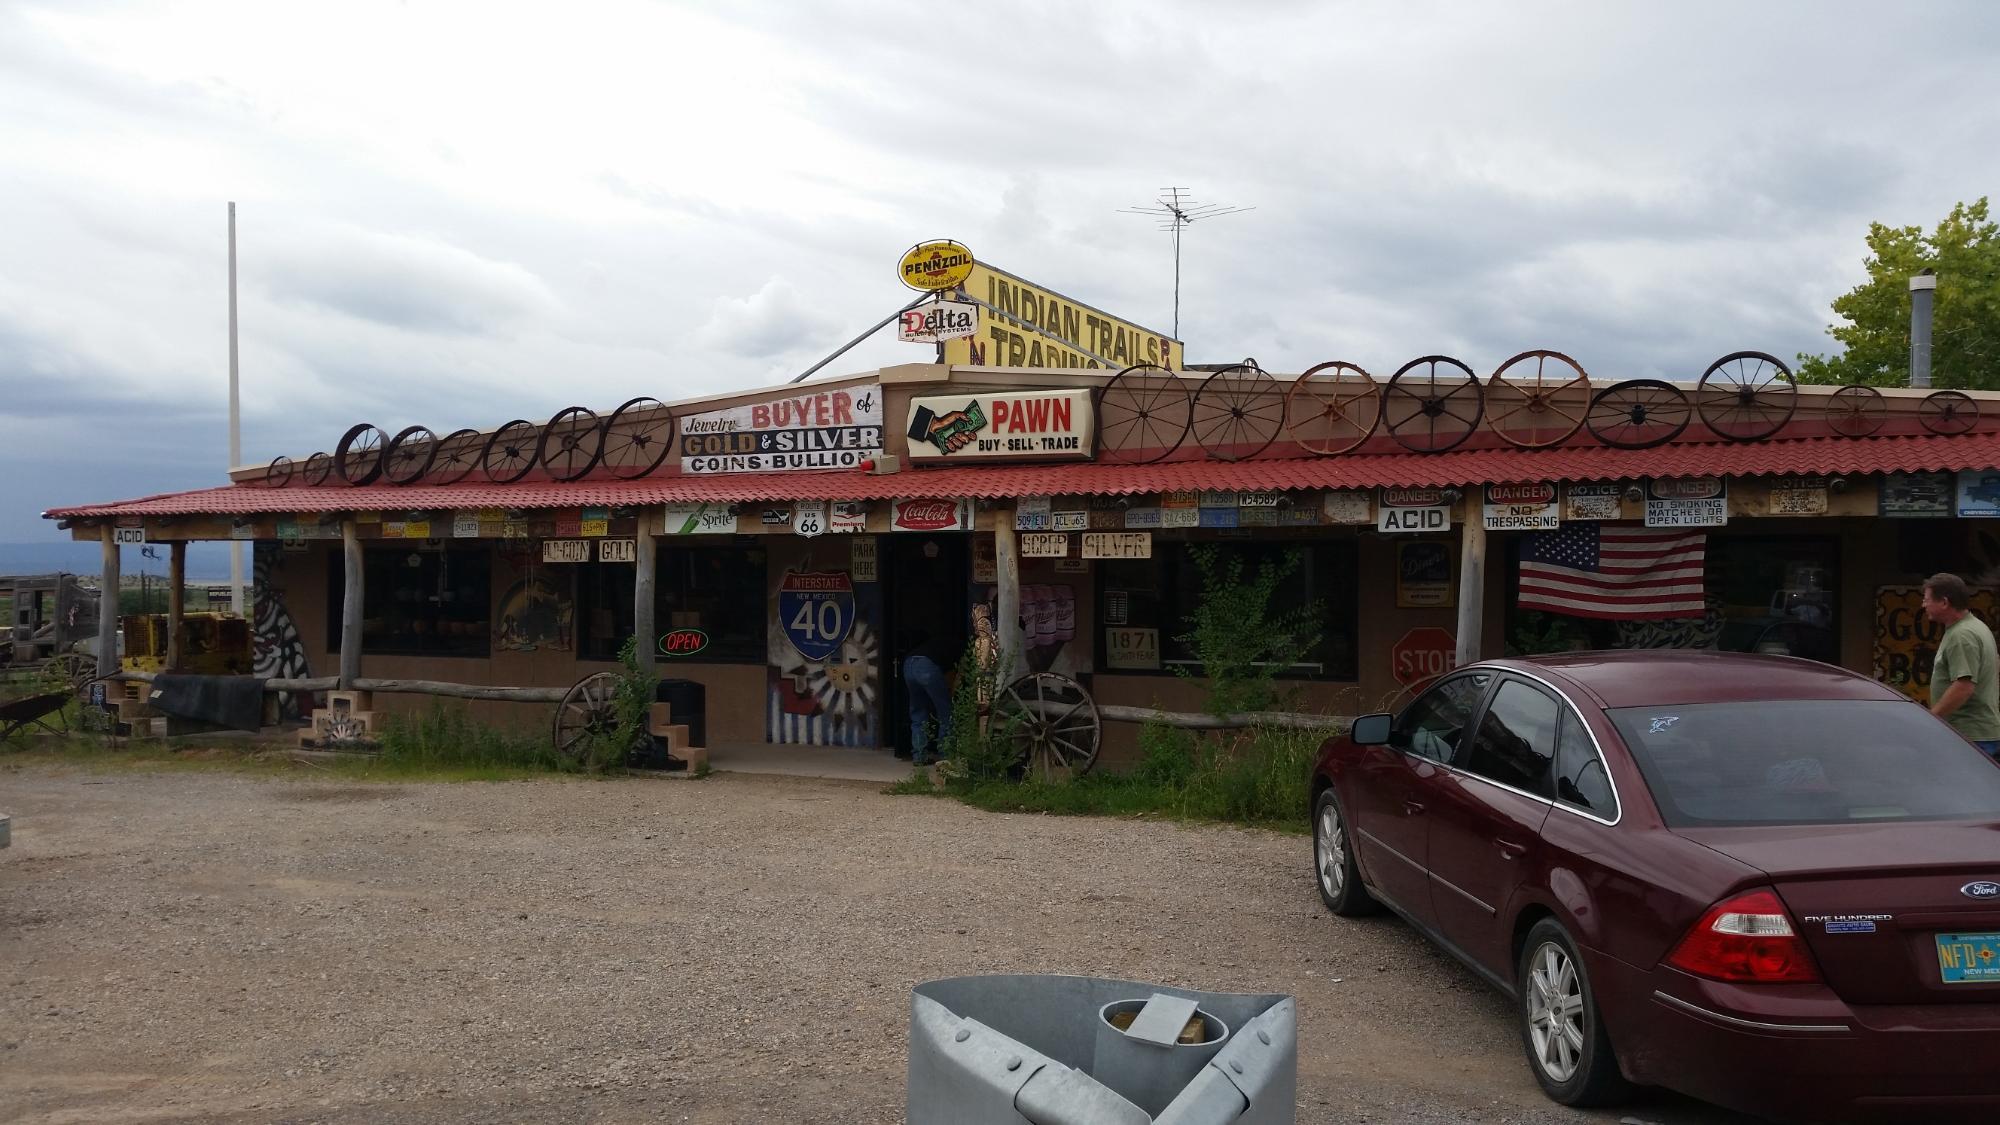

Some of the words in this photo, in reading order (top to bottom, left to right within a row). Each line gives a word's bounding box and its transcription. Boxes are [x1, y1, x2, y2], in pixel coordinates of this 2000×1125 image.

[905, 254, 971, 276] PENNZOIL
[905, 308, 973, 332] Delta
[988, 275, 1080, 347] INDIAN
[1086, 314, 1159, 371] TRAILS
[685, 417, 738, 433] Jewelry
[751, 391, 853, 429] BUYER
[856, 392, 875, 413] of
[992, 397, 1071, 434] PAWN
[684, 433, 756, 456] GOLD
[761, 434, 772, 449] &
[776, 427, 880, 451] SILVER
[979, 438, 1000, 451] BUY
[1008, 438, 1033, 451] SELL
[1041, 436, 1078, 450] TRADE
[1388, 489, 1442, 502] DANGER
[1493, 483, 1551, 499] DANGER
[1510, 506, 1532, 515] NO
[1648, 501, 1663, 509] NO
[702, 513, 733, 529] Sprite
[801, 519, 818, 533] 66
[1384, 509, 1444, 529] ACID
[1486, 516, 1558, 528] TRESPASSING
[116, 530, 143, 543] ACID
[602, 539, 636, 562] GOLD
[854, 543, 875, 558] PARK
[854, 562, 875, 576] HERE
[793, 576, 841, 589] INTERSTATE
[791, 600, 842, 641] 40
[667, 633, 701, 650] OPEN
[1973, 883, 1998, 895] Ford
[1834, 914, 1893, 922] HUNDRED
[1940, 943, 1976, 968] NFD
